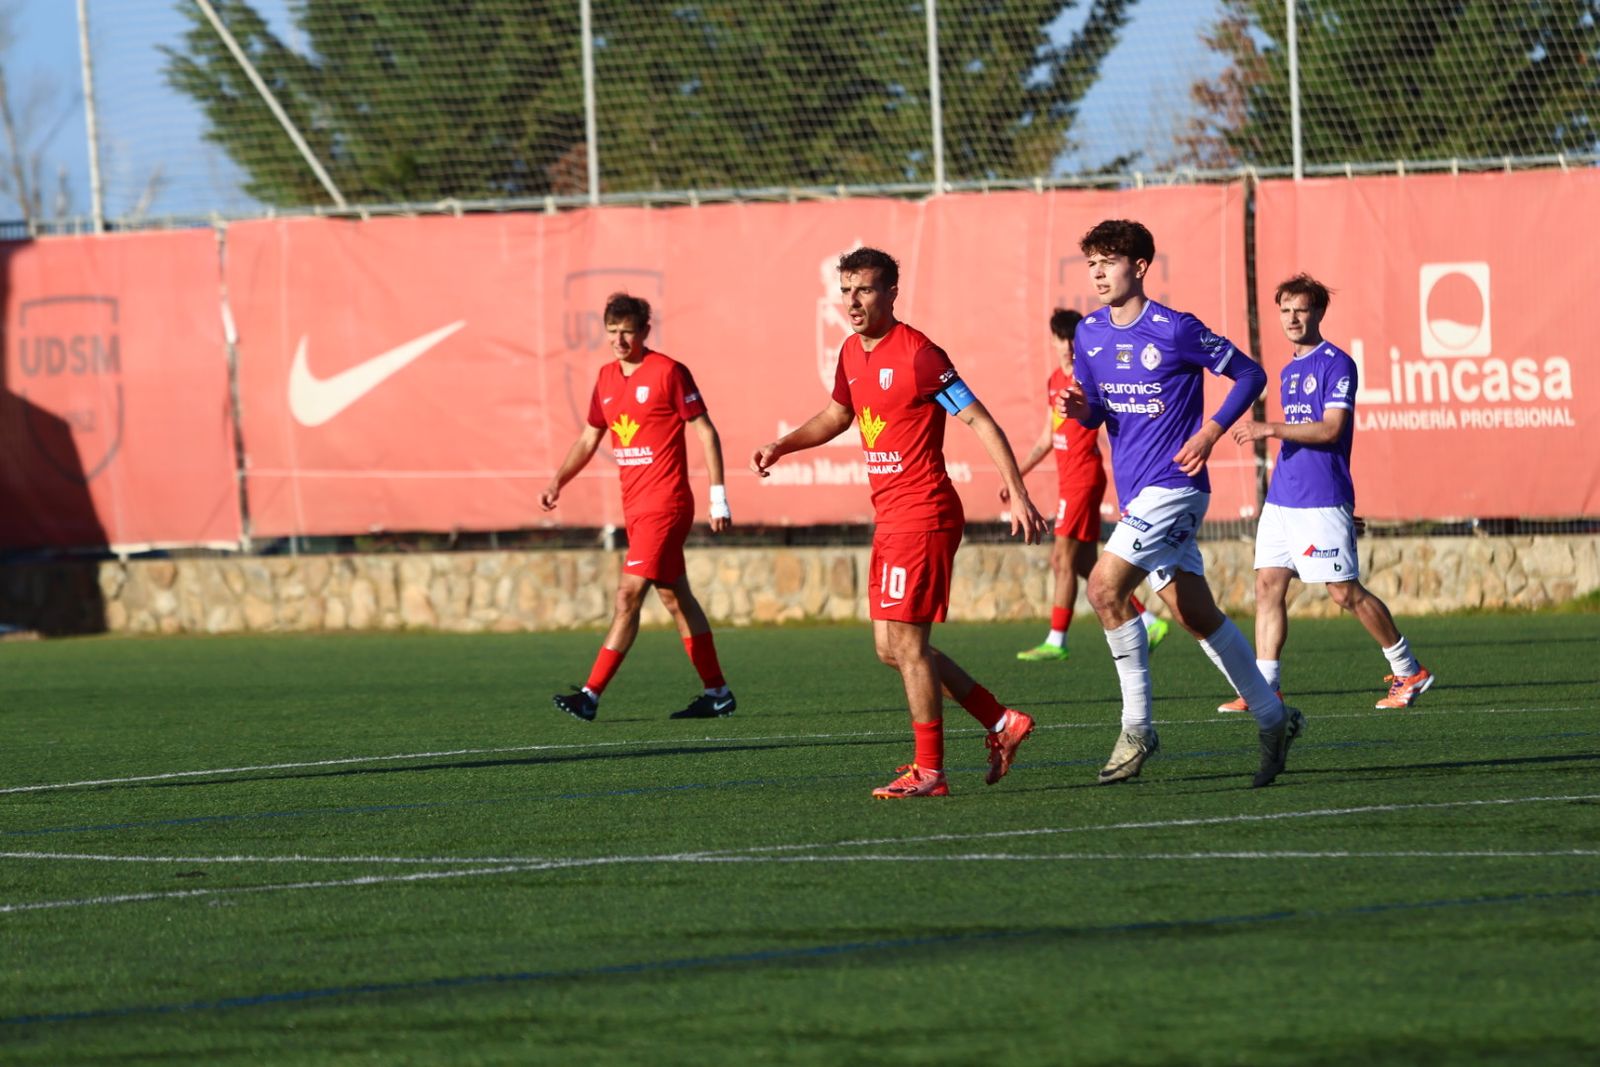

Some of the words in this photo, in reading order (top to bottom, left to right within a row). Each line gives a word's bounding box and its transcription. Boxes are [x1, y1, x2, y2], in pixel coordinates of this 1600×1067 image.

[20, 333, 121, 377] UDSM
[1352, 341, 1573, 404] Limcasa
[1104, 381, 1162, 395] euronics
[1356, 407, 1457, 431] LAVANDERÍA
[1461, 407, 1575, 431] PROFESIONAL
[881, 563, 907, 599] 10
